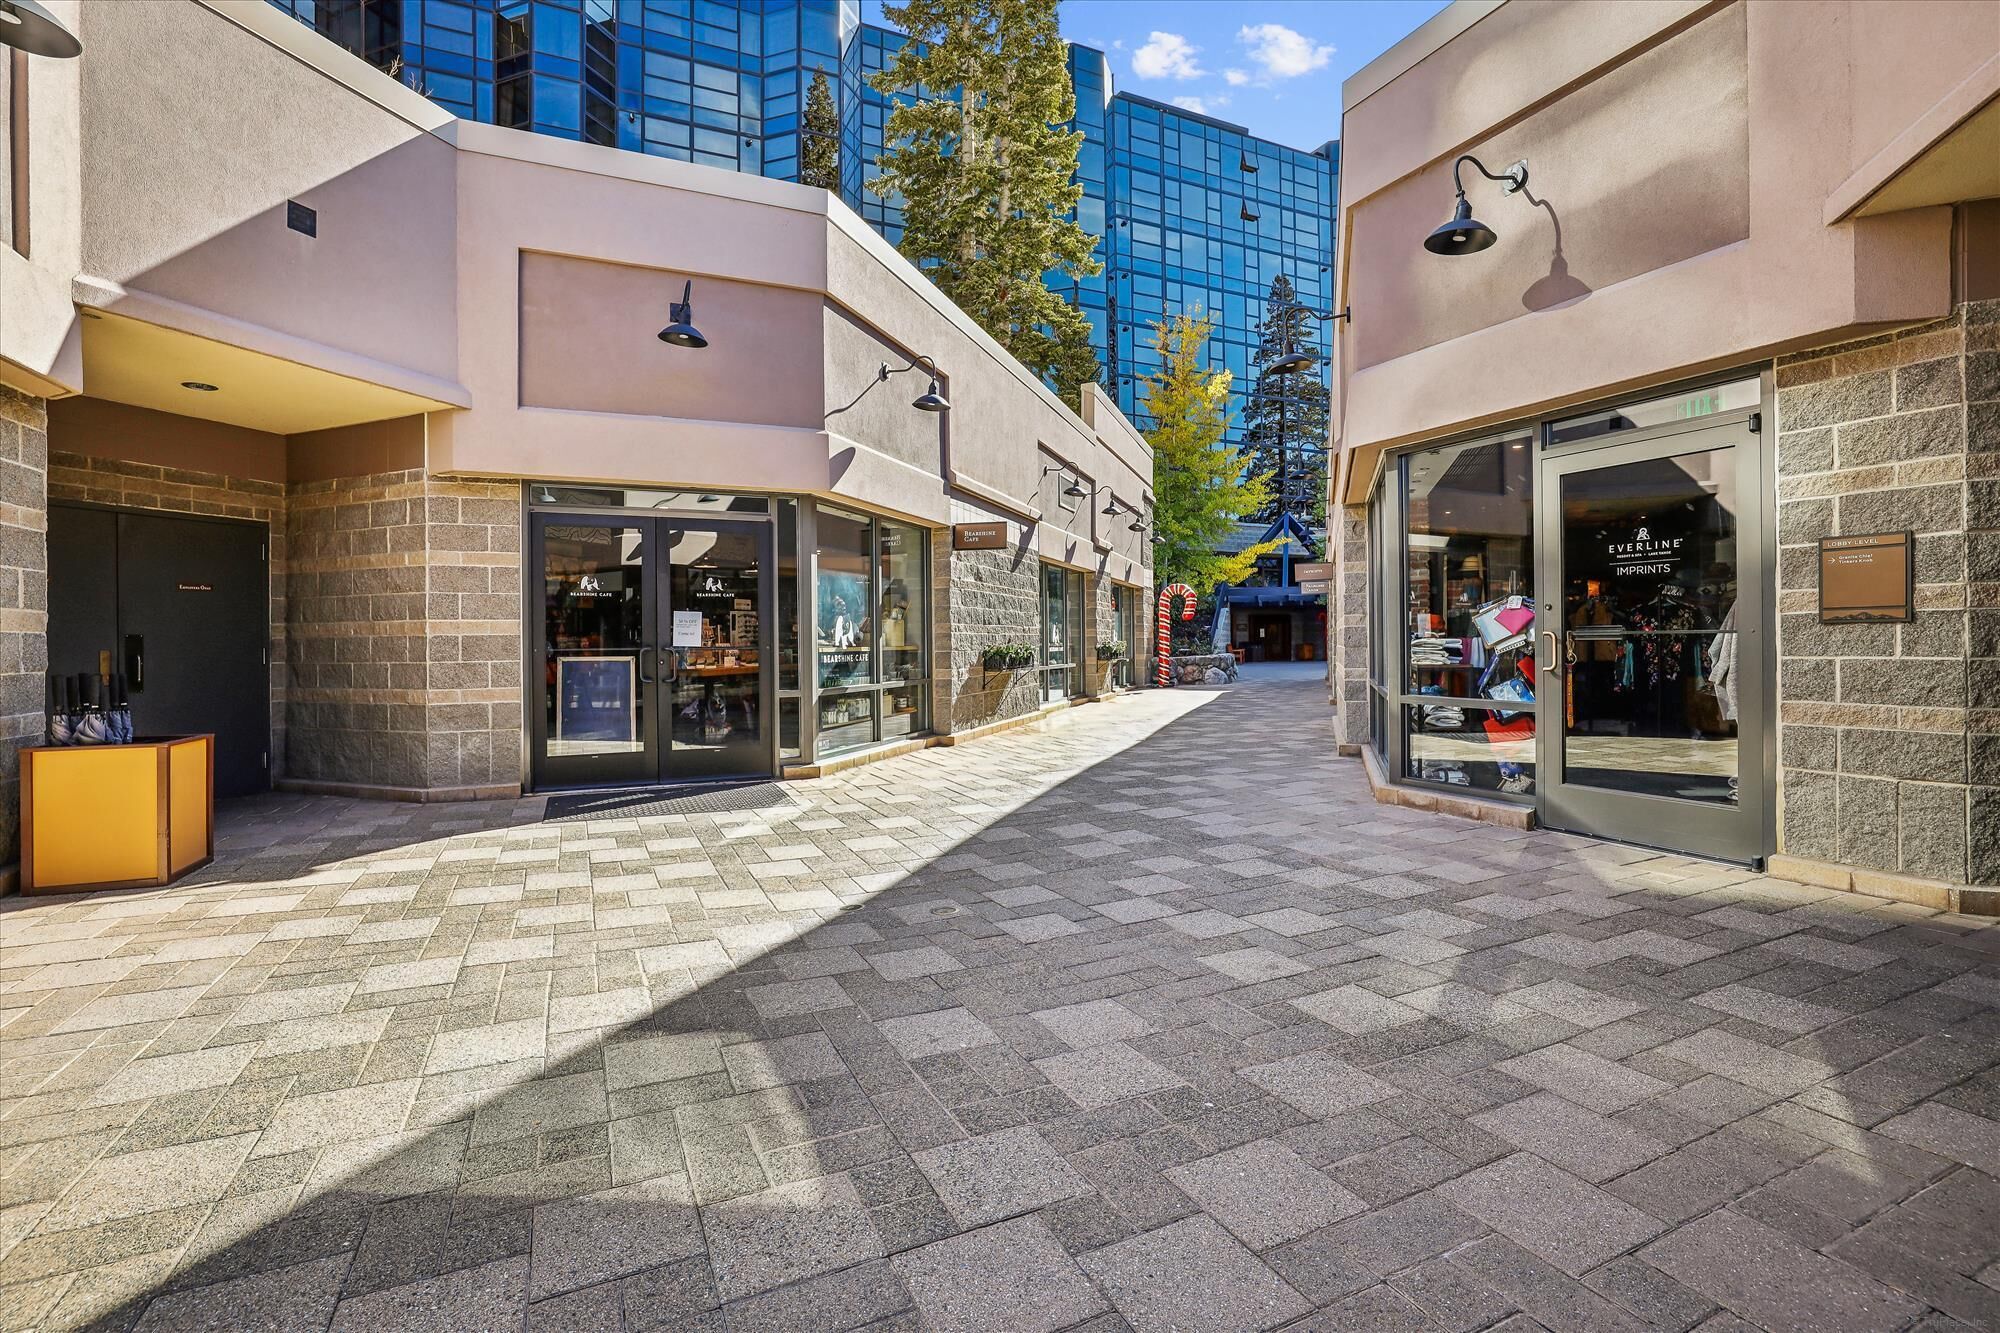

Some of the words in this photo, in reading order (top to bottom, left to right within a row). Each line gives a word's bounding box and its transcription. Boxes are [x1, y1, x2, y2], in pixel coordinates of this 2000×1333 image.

[1617, 564, 1671, 575] IMPRINTS
[823, 654, 854, 664] BEARSHINE
[854, 653, 869, 662] CAFE
